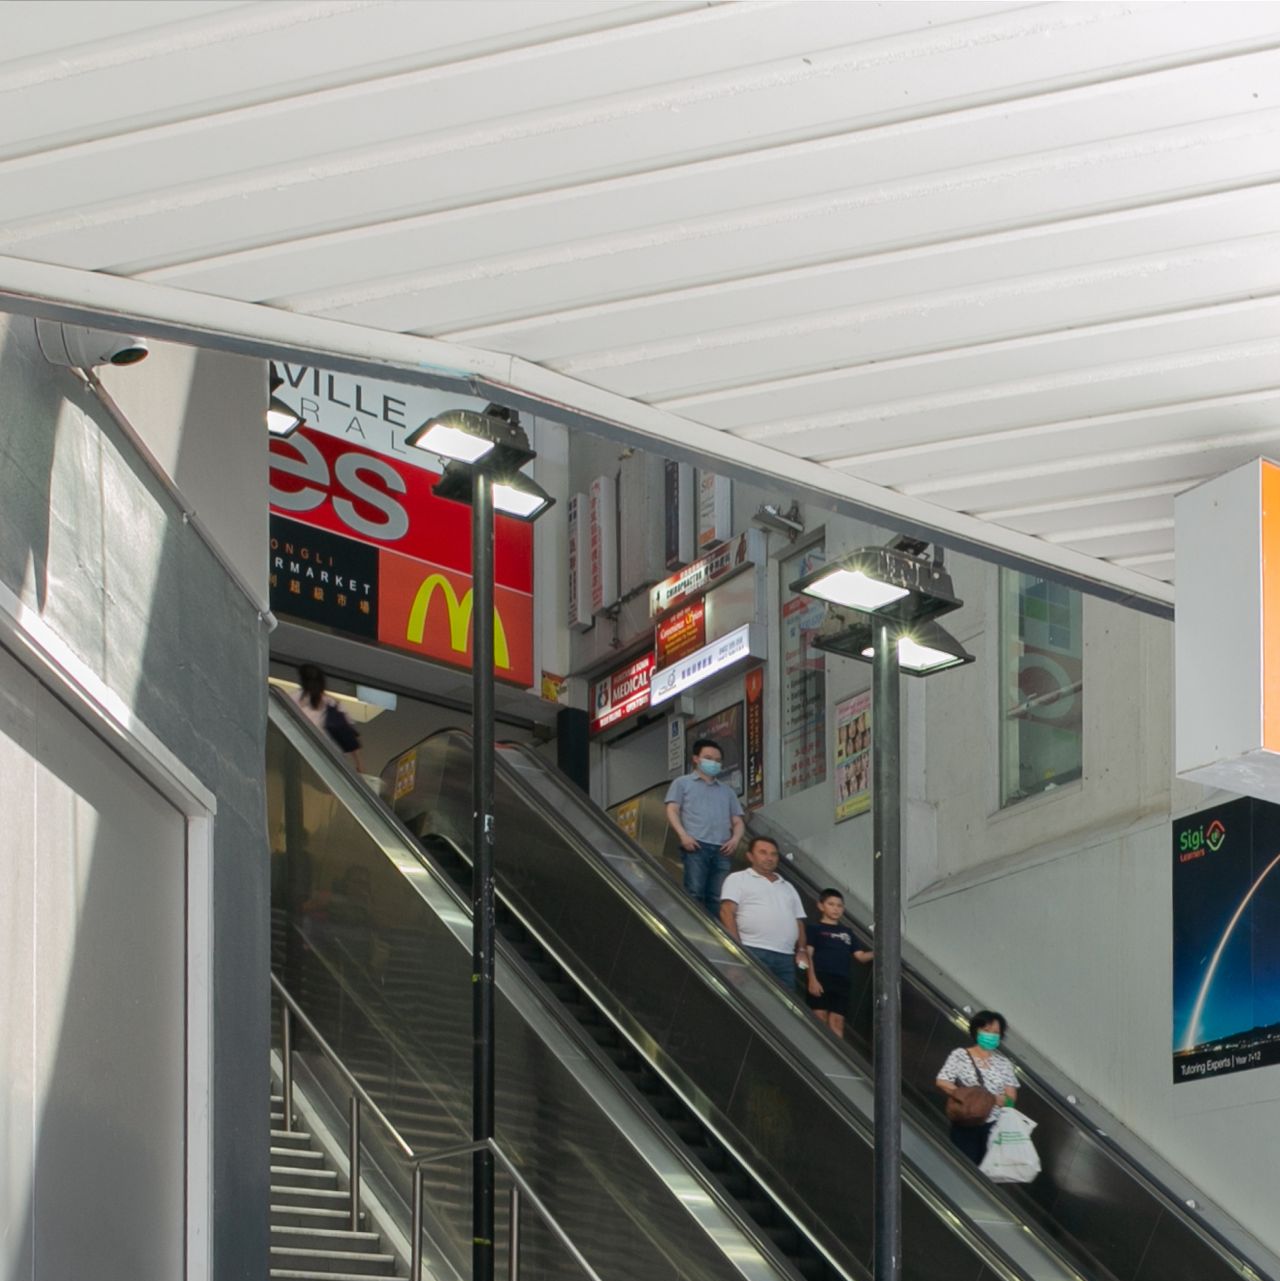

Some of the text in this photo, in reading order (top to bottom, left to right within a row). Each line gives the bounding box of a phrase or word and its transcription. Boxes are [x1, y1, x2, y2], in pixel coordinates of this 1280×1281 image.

[613, 670, 648, 701] MEDICAL
[1181, 1060, 1206, 1076] Tutoring
[1207, 1058, 1231, 1073] Experts
